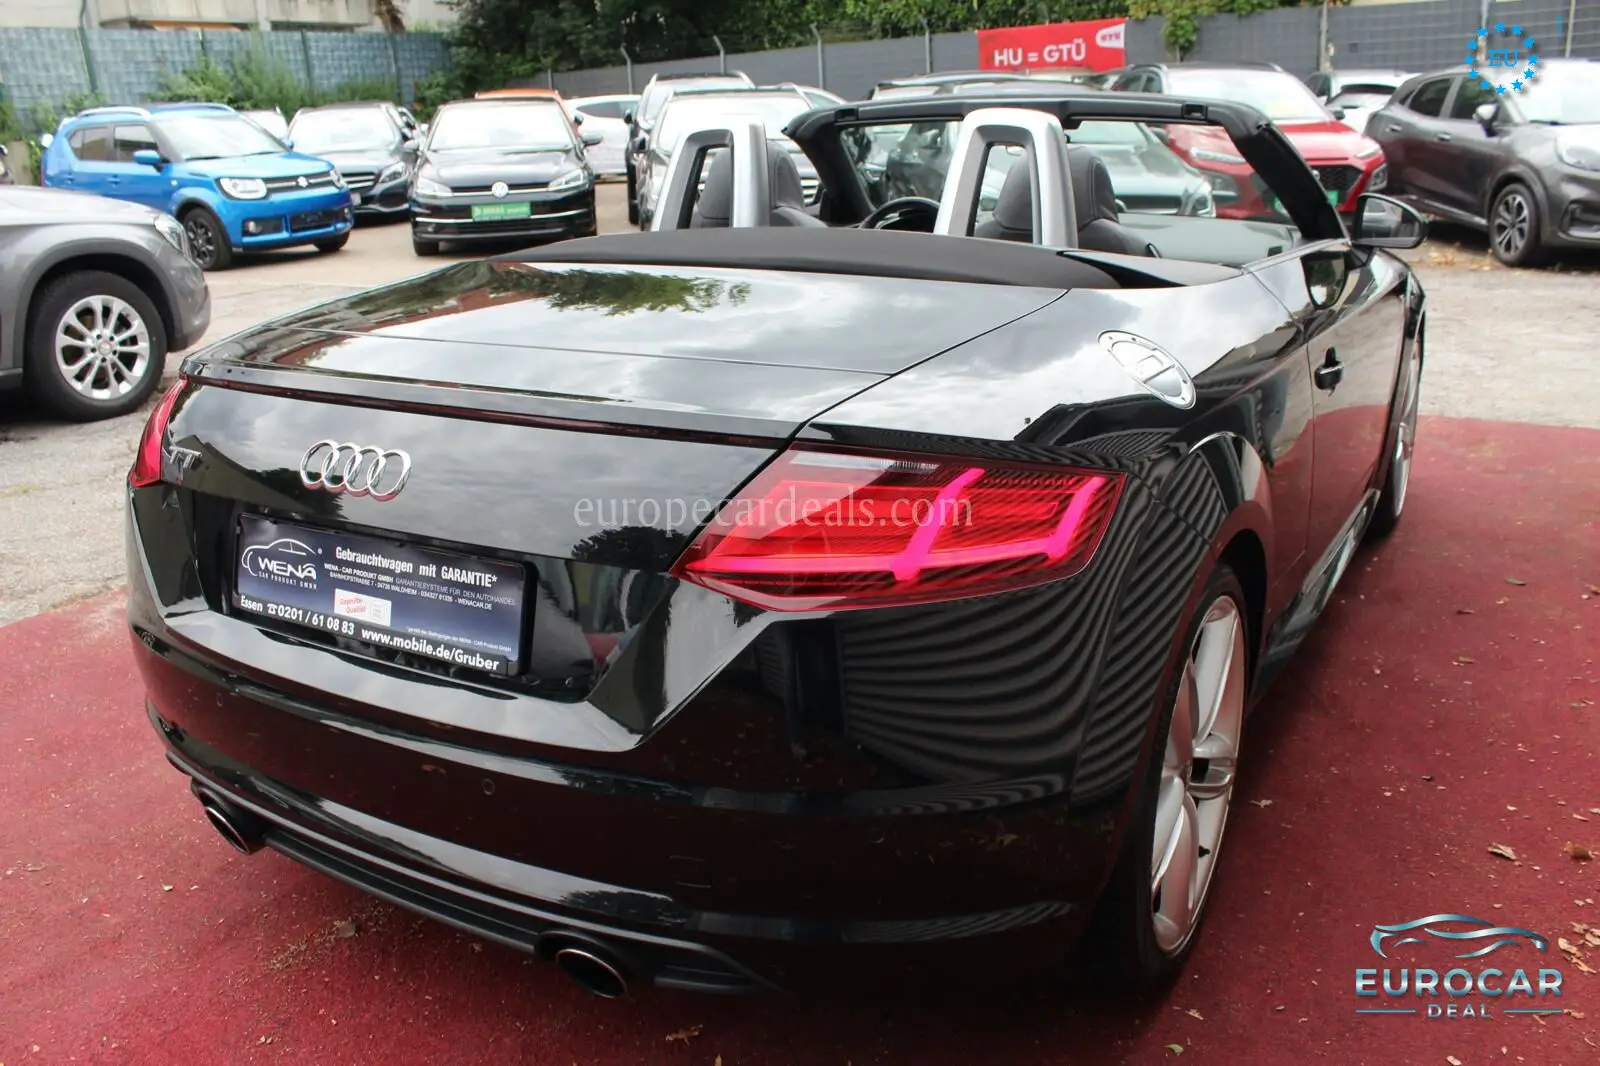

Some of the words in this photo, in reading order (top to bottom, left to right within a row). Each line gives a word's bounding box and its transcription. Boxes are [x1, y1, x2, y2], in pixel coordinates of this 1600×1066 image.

[994, 47, 1022, 66] HU
[1043, 38, 1086, 63] GTÜ
[335, 546, 413, 574] Gebrauchtwagen
[419, 563, 437, 578] mit
[240, 595, 263, 612] Essen
[312, 614, 324, 627] 61
[327, 618, 340, 631] 08
[342, 621, 355, 636] 83
[361, 628, 500, 671] www.mobile.de/Gruber
